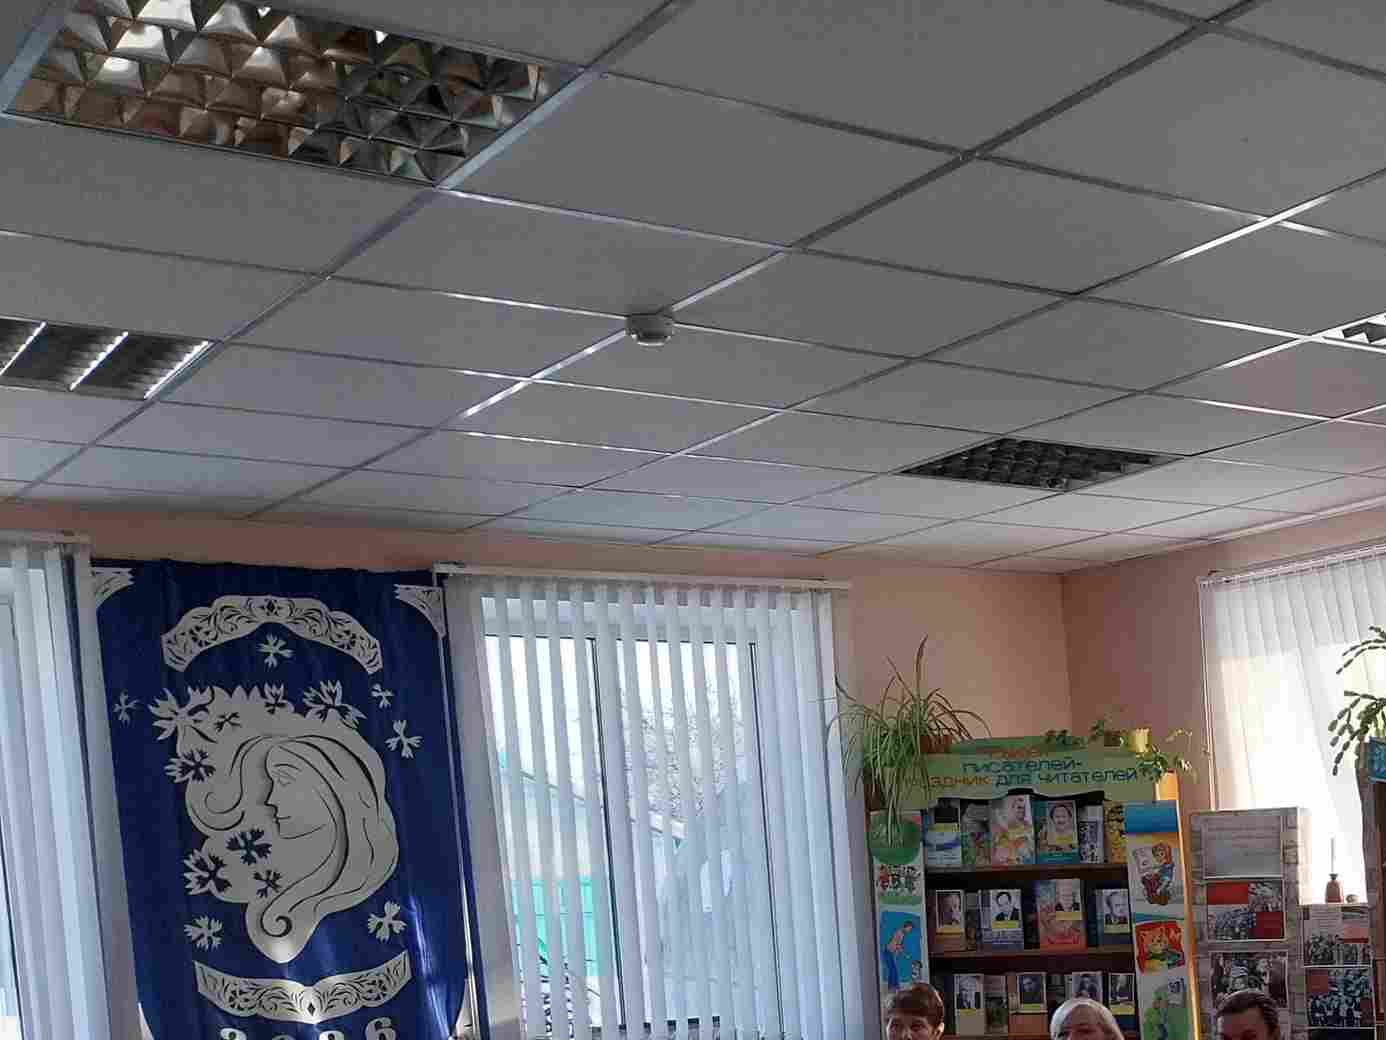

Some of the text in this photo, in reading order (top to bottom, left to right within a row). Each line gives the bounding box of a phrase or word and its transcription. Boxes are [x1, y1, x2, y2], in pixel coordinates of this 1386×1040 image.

[962, 757, 1082, 773] писателей-
[996, 774, 1032, 788] для
[1039, 766, 1138, 784] читателей
